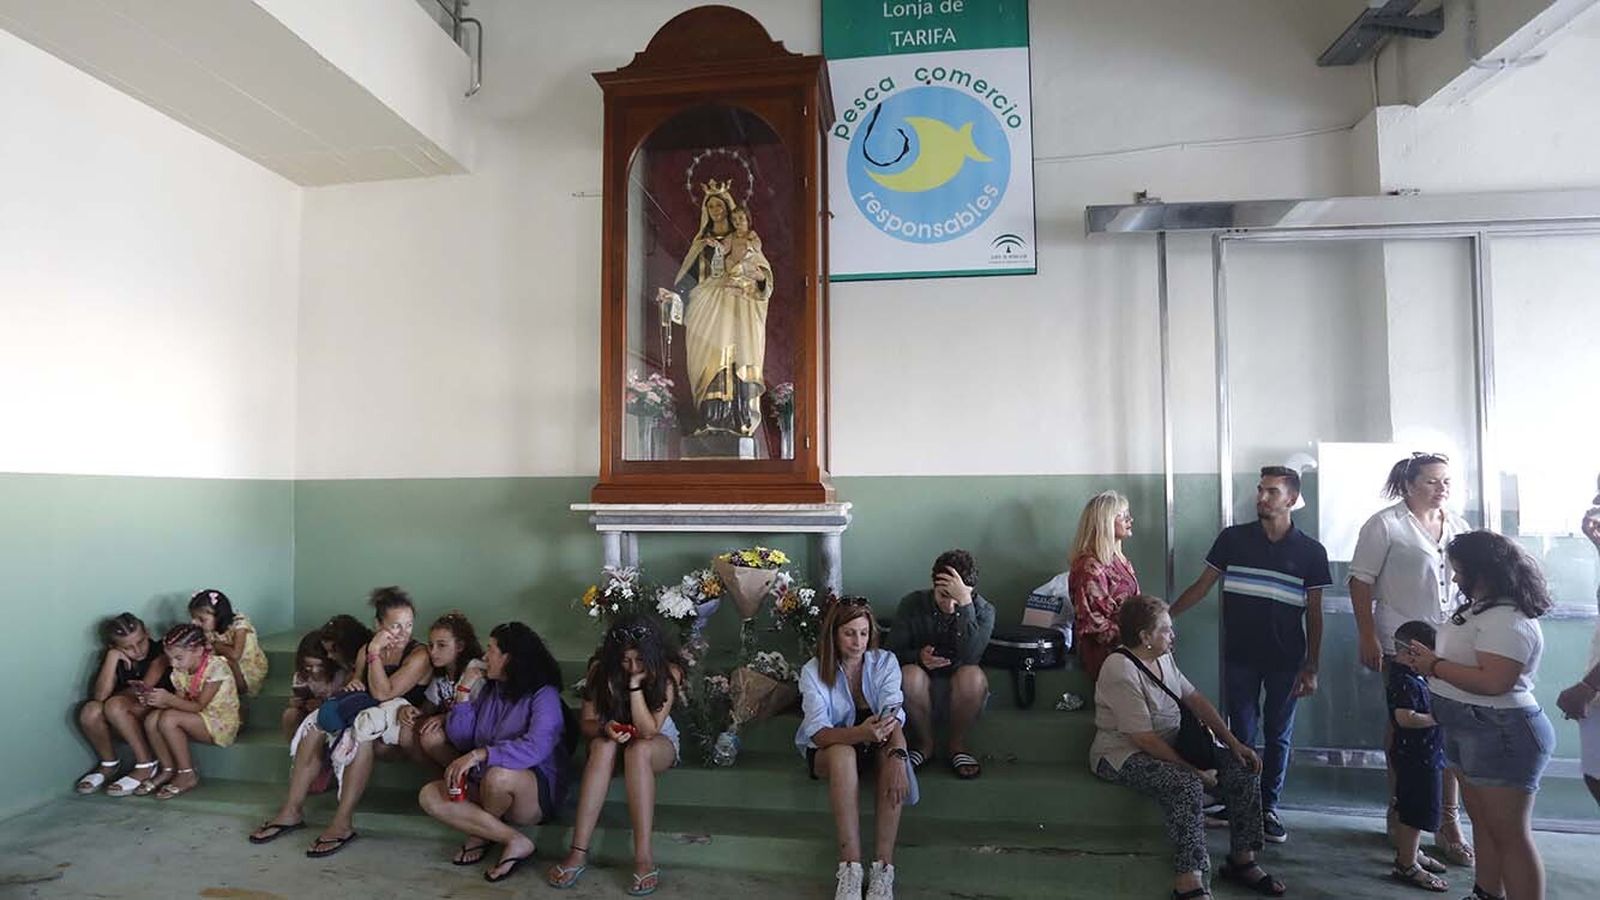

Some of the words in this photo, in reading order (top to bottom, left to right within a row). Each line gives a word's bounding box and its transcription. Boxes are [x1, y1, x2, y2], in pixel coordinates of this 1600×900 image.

[883, 0, 933, 19] Lonja
[940, 0, 964, 13] de
[890, 28, 957, 47] TARIFA
[834, 76, 895, 140] pesca
[914, 66, 1022, 129] comercio
[860, 184, 999, 238] responsables
